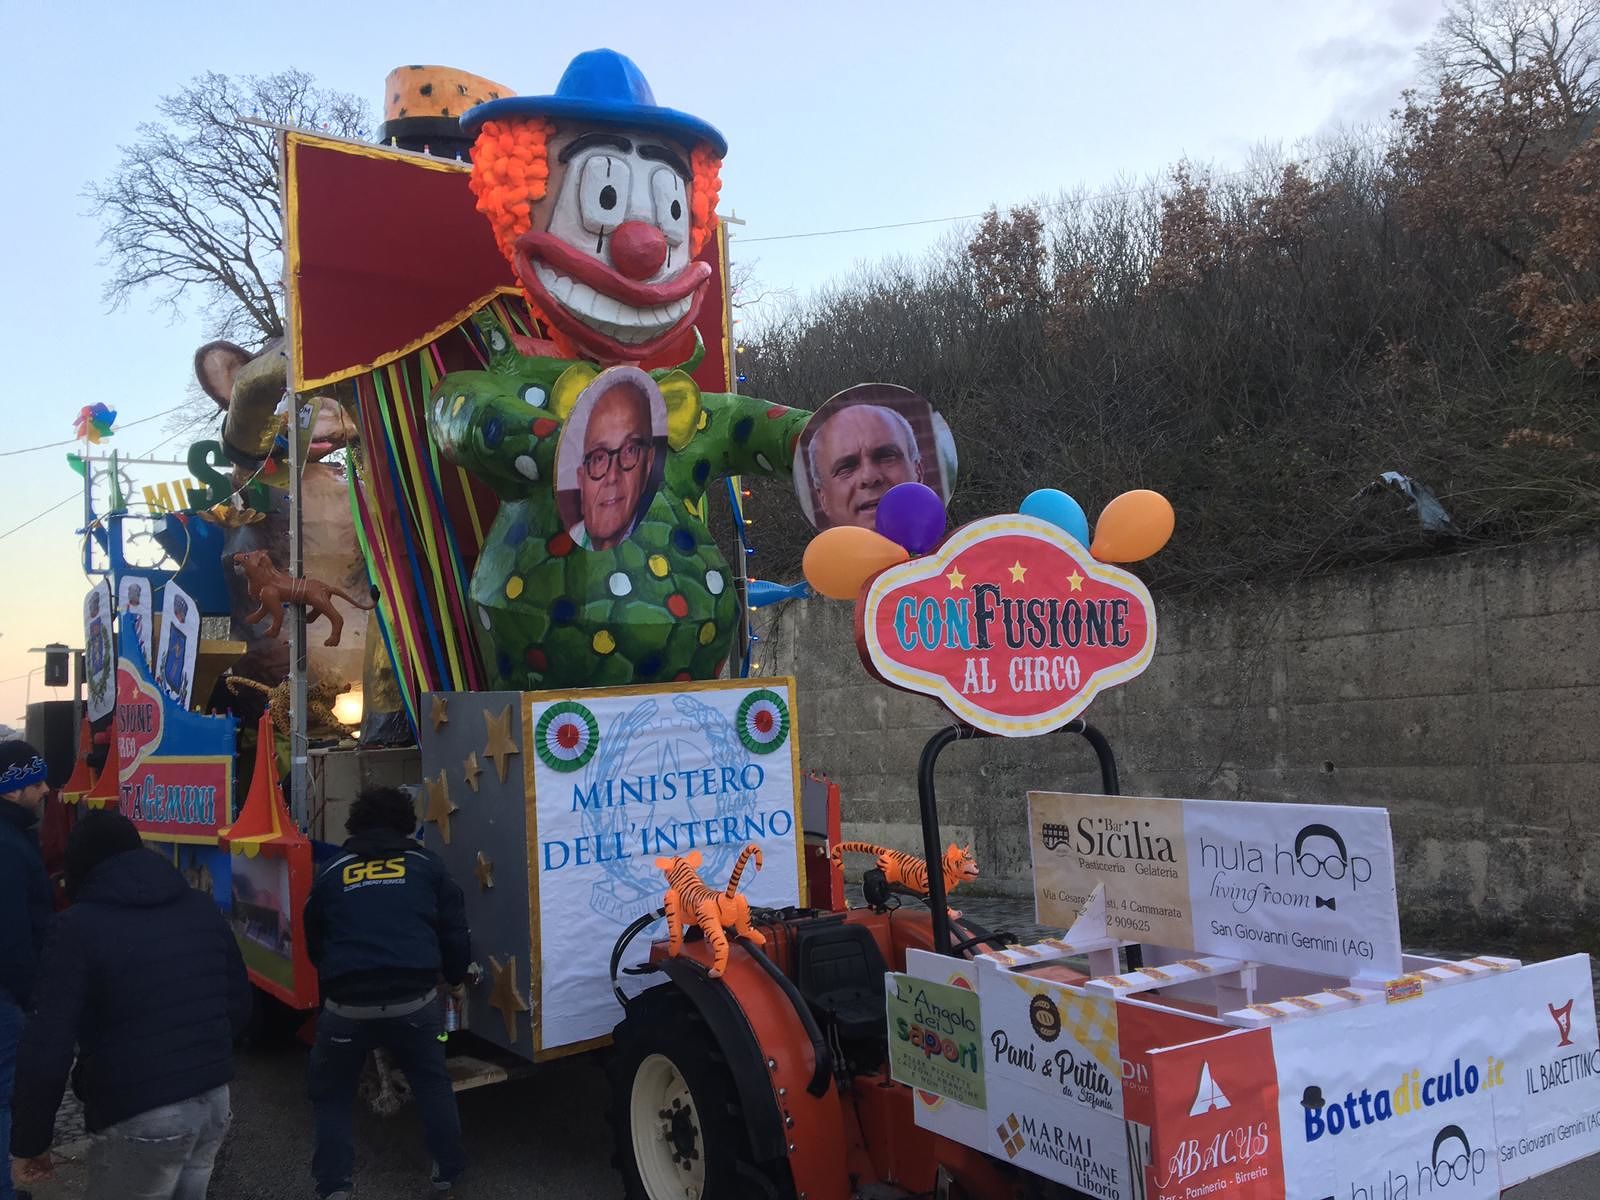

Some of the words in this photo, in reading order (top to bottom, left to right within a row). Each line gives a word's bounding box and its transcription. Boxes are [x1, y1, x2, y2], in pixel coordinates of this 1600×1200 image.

[961, 657, 997, 694] AL
[1008, 655, 1080, 693] CIRCO
[569, 763, 765, 813] MINISTERO
[542, 809, 793, 872] DELL'INTERNO
[1076, 817, 1177, 863] Sicilia
[1105, 818, 1123, 833] Bar
[343, 857, 406, 885] GES
[1079, 858, 1126, 873] Pasticceria
[1135, 863, 1179, 879] Gelateria
[1200, 837, 1264, 873] hula
[1275, 842, 1372, 891] hoop
[1042, 888, 1057, 900] Via
[1121, 901, 1127, 910] 4
[1130, 901, 1182, 919] Cammarata
[1209, 871, 1268, 914] living
[1263, 886, 1311, 909] room
[1114, 916, 1151, 932] 909625
[1211, 920, 1232, 936] San
[1234, 923, 1289, 946] Giovanni
[1291, 931, 1338, 953] Gemini
[1342, 938, 1374, 960] (AG)
[914, 1008, 940, 1031] dei
[991, 1029, 1037, 1073] Pani
[1041, 1058, 1053, 1077] &
[1054, 1049, 1113, 1097] Putia
[1526, 1068, 1539, 1095] IL
[1540, 1049, 1600, 1091] BARETTINO
[1022, 1115, 1092, 1158] MARMI
[1154, 1122, 1269, 1189] ABACUS
[1500, 1145, 1517, 1162] San
[1518, 1128, 1556, 1155] Giovanni
[1557, 1120, 1586, 1141] Gemini
[1029, 1138, 1119, 1185] MANGIAPANE
[1416, 1148, 1486, 1196] hoop
[1076, 1171, 1120, 1200] Liborio
[1186, 1179, 1227, 1200] Panineria
[1235, 1166, 1268, 1184] Birreria
